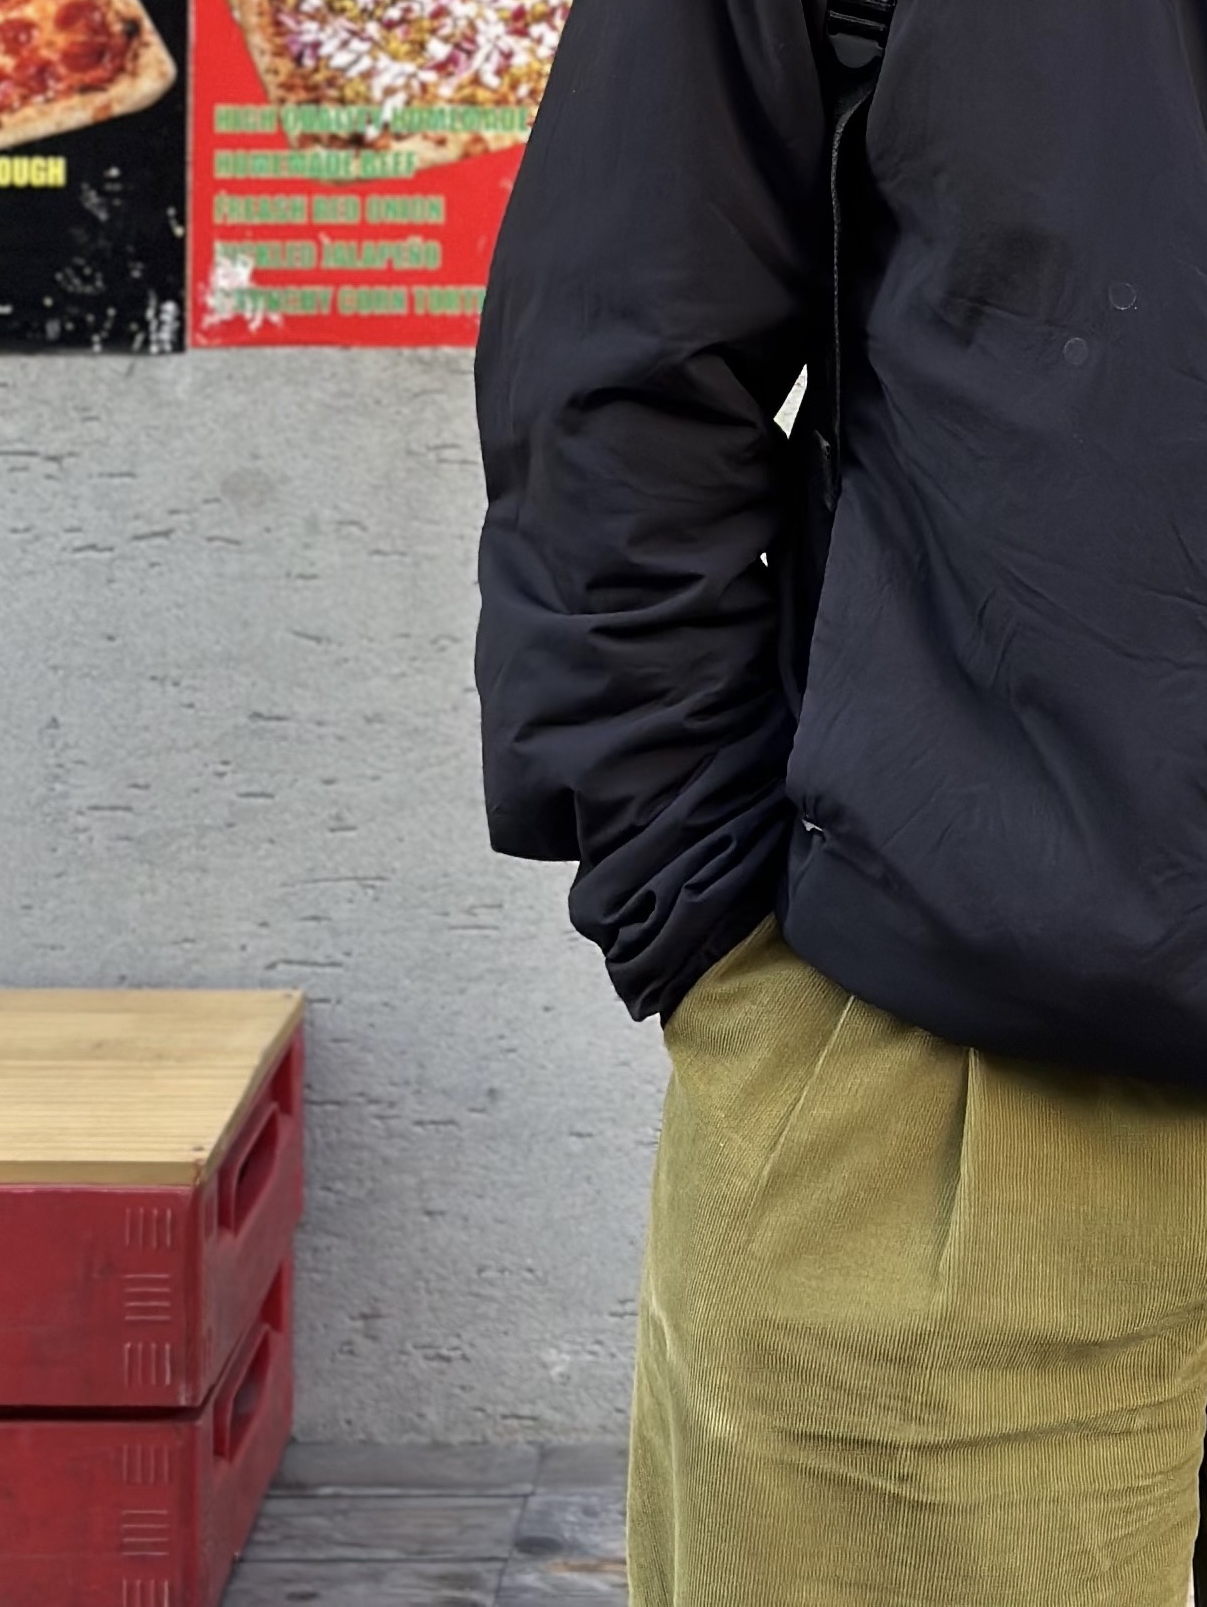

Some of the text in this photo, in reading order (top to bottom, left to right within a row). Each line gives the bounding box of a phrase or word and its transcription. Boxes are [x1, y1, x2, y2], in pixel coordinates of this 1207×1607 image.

[312, 195, 360, 225] RED
[365, 195, 445, 225] ONION
[338, 286, 407, 316] CORN
